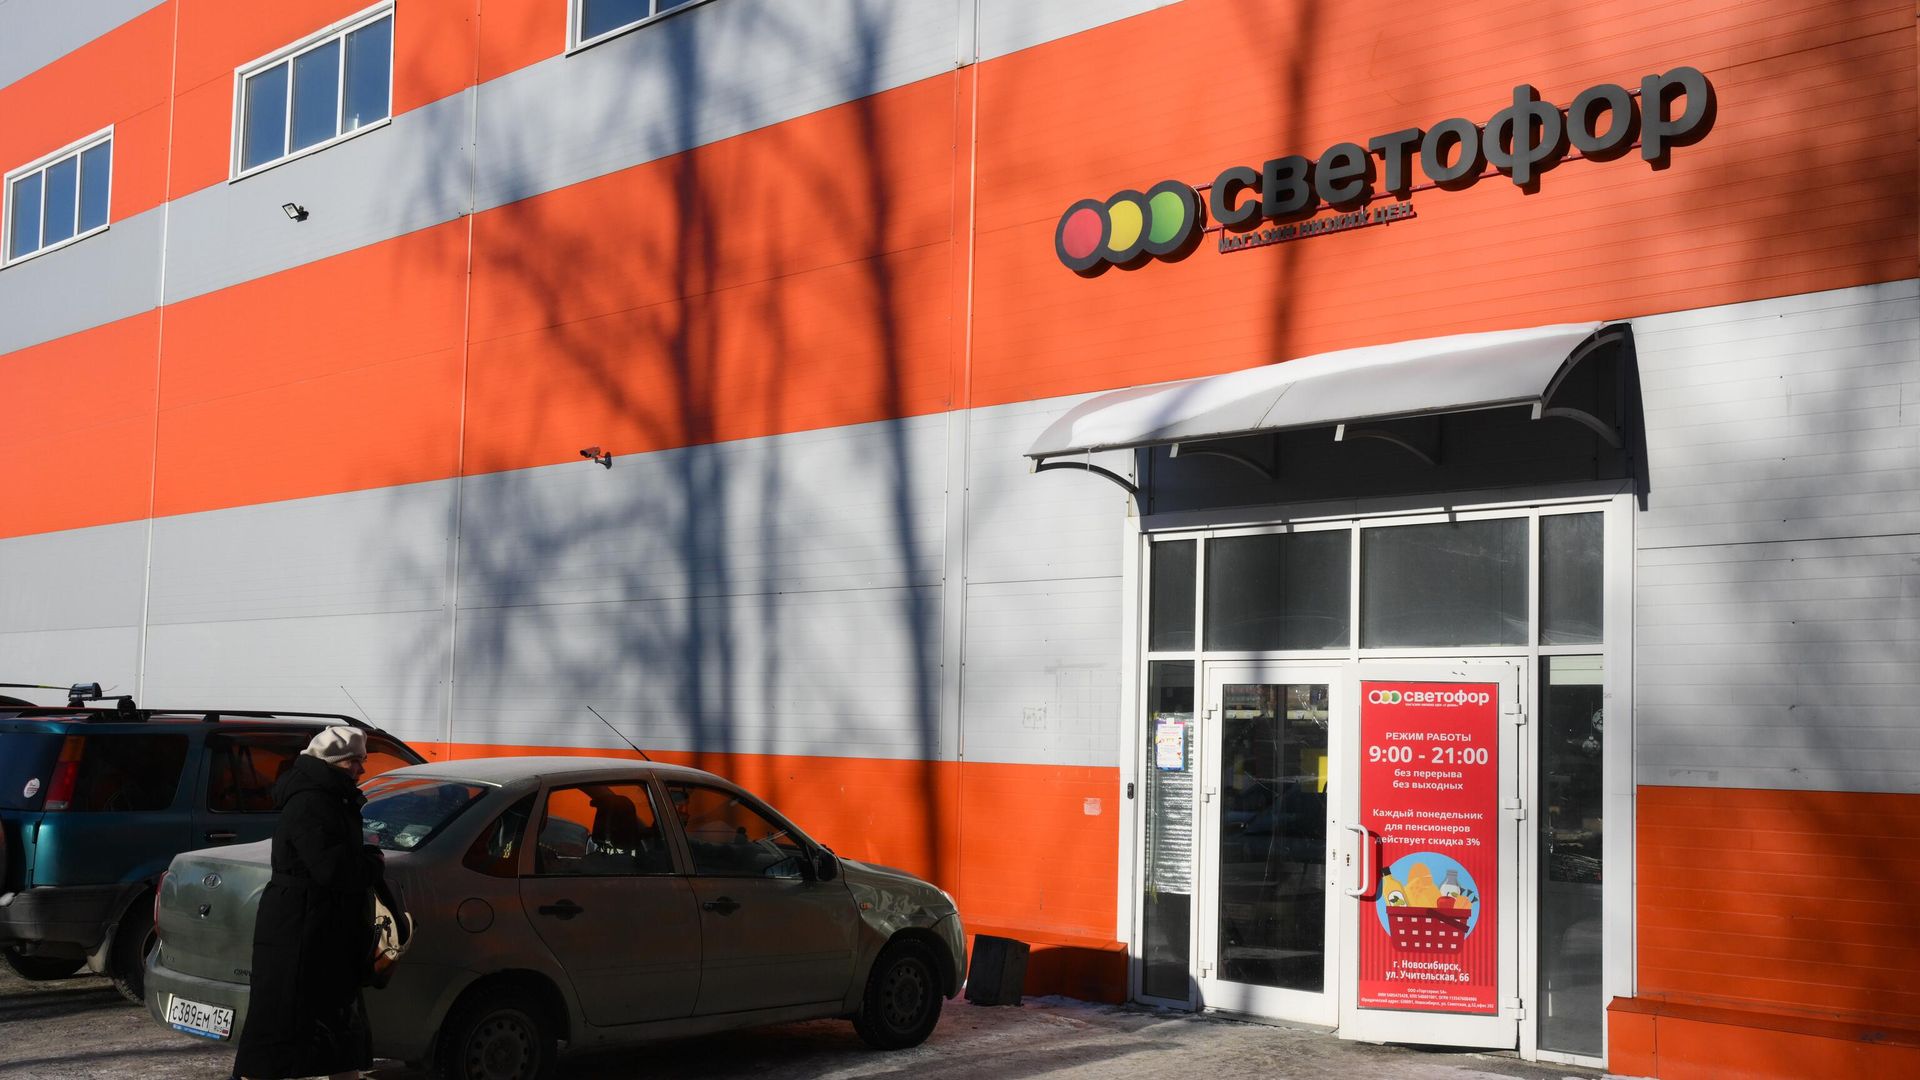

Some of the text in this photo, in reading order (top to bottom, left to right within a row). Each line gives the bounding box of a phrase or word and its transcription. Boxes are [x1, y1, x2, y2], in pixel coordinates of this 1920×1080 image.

[1210, 66, 1716, 229] светофор
[1218, 201, 1413, 251] МАГАЗИН НИЗКИХ ЦЕН
[1403, 689, 1489, 706] светофор
[1385, 732, 1472, 742] РЕЖИМ РАБОТЫ
[1368, 745, 1413, 763] 9:00
[1431, 746, 1489, 765] 21:00
[1394, 768, 1463, 779] без перерыва
[1392, 780, 1463, 791] без выходных
[1372, 808, 1483, 820] Каждый понедельник
[1384, 823, 1471, 834] для пенсионеров
[1375, 834, 1481, 847] действует скидка 3%
[1393, 959, 1461, 972] г. Новосибирск,
[1385, 970, 1470, 982] ул. Учительская, 66
[172, 1002, 230, 1029] С389ЕМ 154
